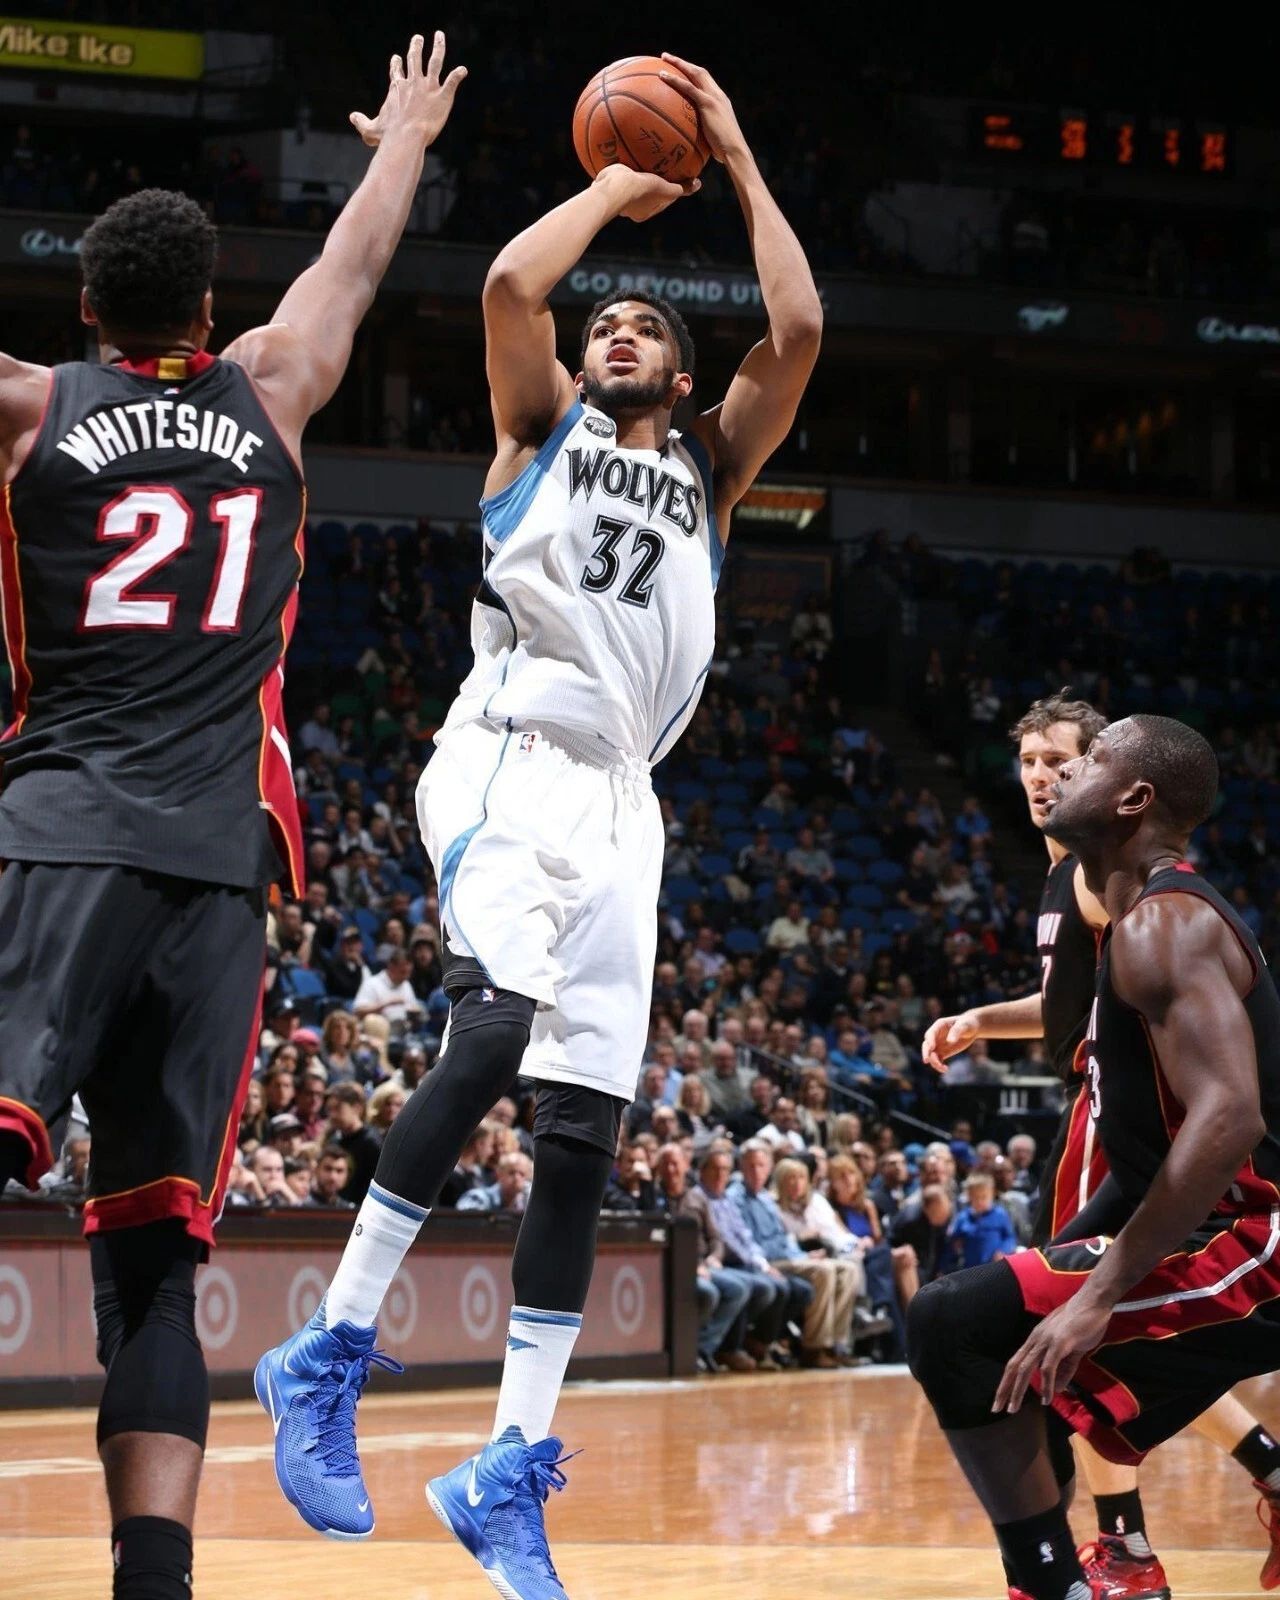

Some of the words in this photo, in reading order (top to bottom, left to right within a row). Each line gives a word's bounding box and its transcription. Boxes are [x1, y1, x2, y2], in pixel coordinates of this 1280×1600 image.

[79, 34, 133, 66] Ike
[570, 270, 612, 294] GO
[618, 272, 724, 303] BEYOND
[57, 400, 263, 474] WHITESIDE
[565, 447, 702, 537] WOLVES
[76, 485, 264, 632] 21
[580, 515, 665, 609] 32
